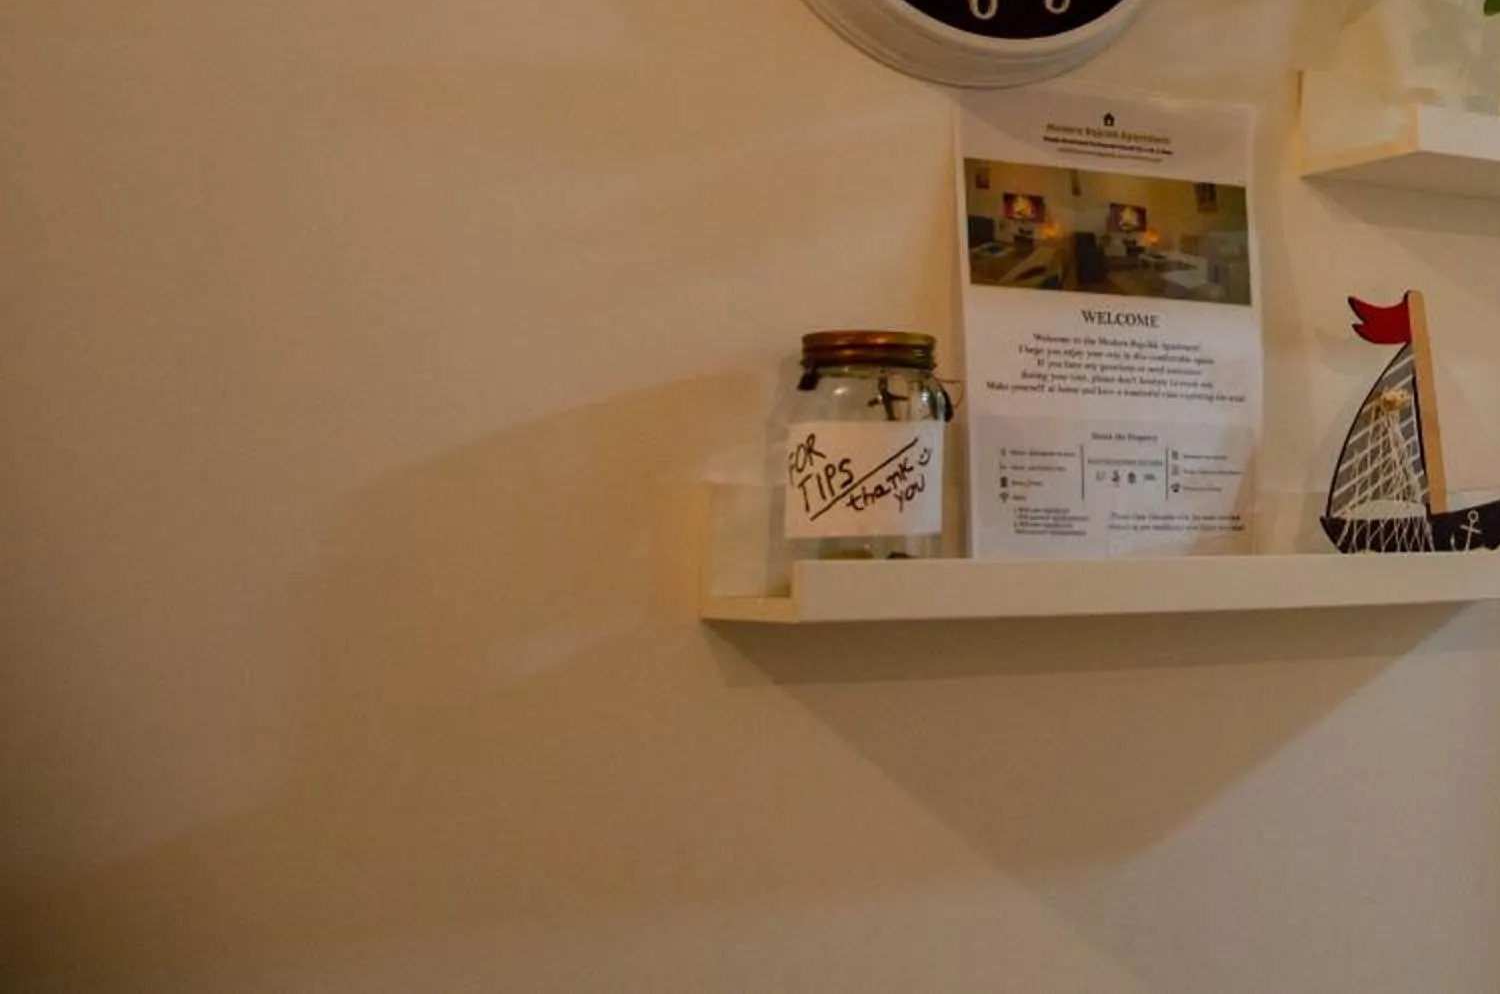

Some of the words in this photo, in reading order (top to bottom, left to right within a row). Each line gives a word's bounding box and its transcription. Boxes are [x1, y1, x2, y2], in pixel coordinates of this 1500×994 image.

[1081, 310, 1160, 328] WELCOME
[789, 433, 827, 488] FOR
[797, 458, 854, 513] TIPS
